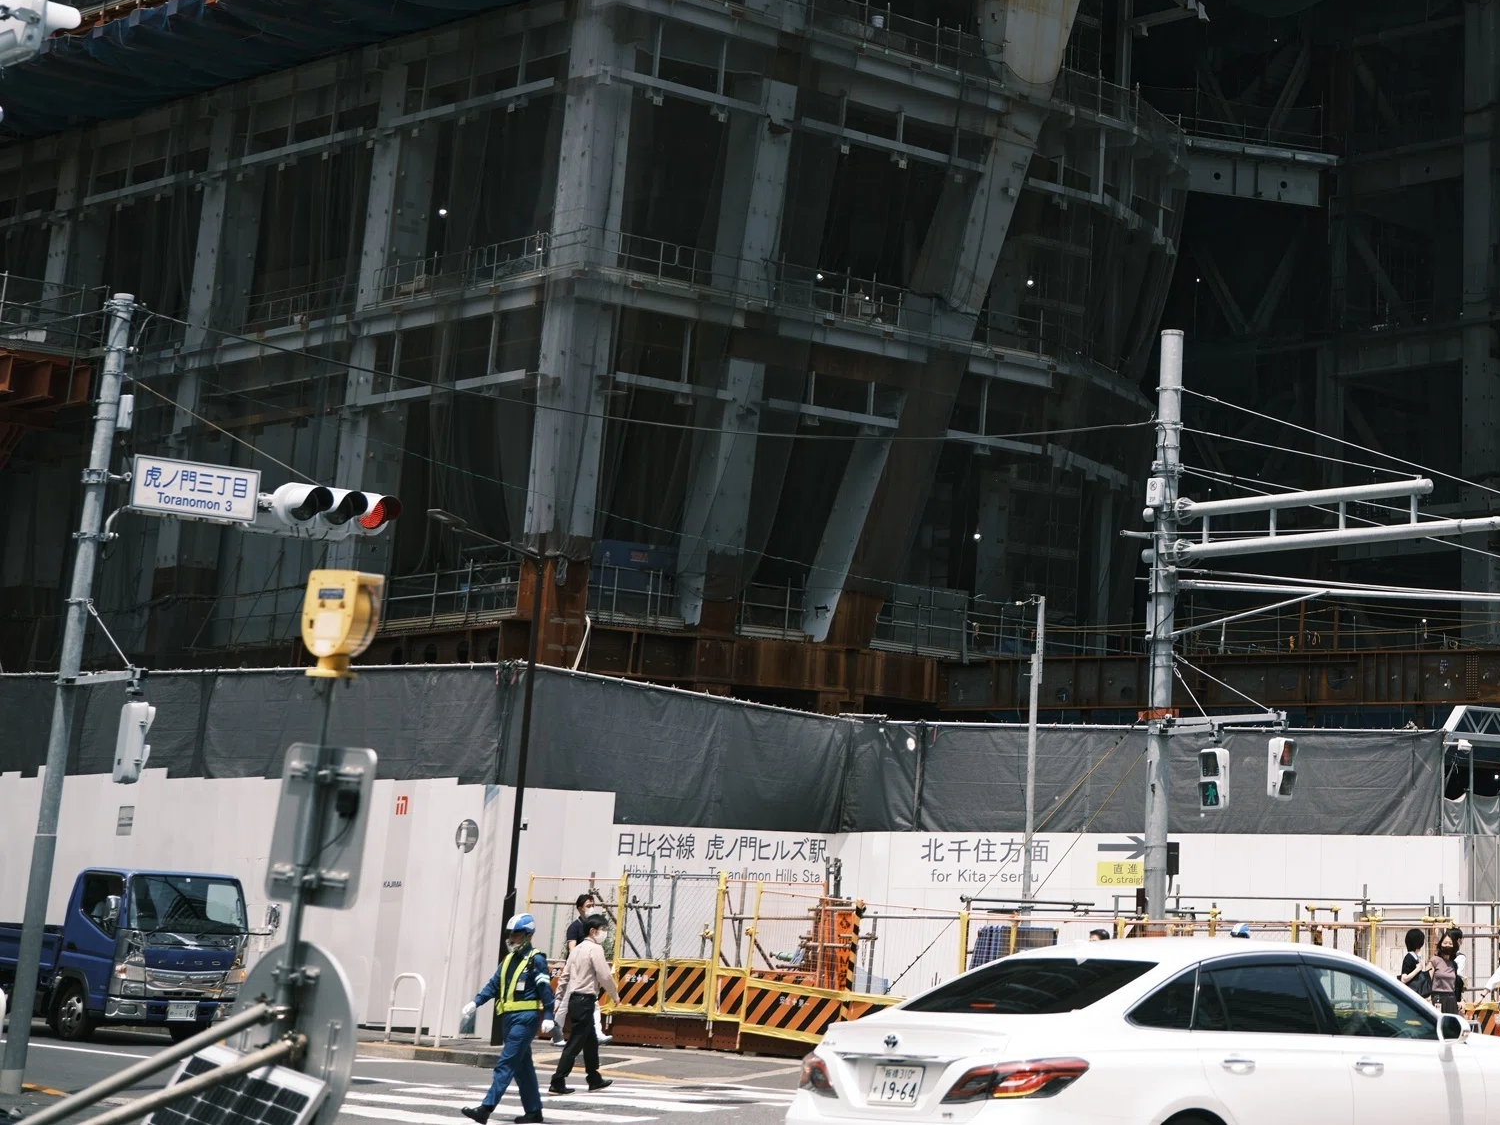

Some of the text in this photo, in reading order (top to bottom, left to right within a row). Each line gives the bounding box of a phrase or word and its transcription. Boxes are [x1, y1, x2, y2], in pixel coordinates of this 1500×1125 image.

[143, 465, 248, 499] 虎ノ門三丁目
[157, 491, 233, 512] Toranomon 3
[617, 832, 828, 864] 日比谷線 虎ノ門ヒルズ駅
[920, 837, 1051, 864] 北千住方面
[775, 868, 798, 883] Hills
[802, 869, 823, 883] Sta.
[931, 868, 1039, 883] for Kita-senu
[1113, 863, 1139, 875] 直進
[383, 880, 402, 889] KAJIMA
[1100, 874, 1113, 884] Go
[880, 1080, 918, 1101] 19-64
